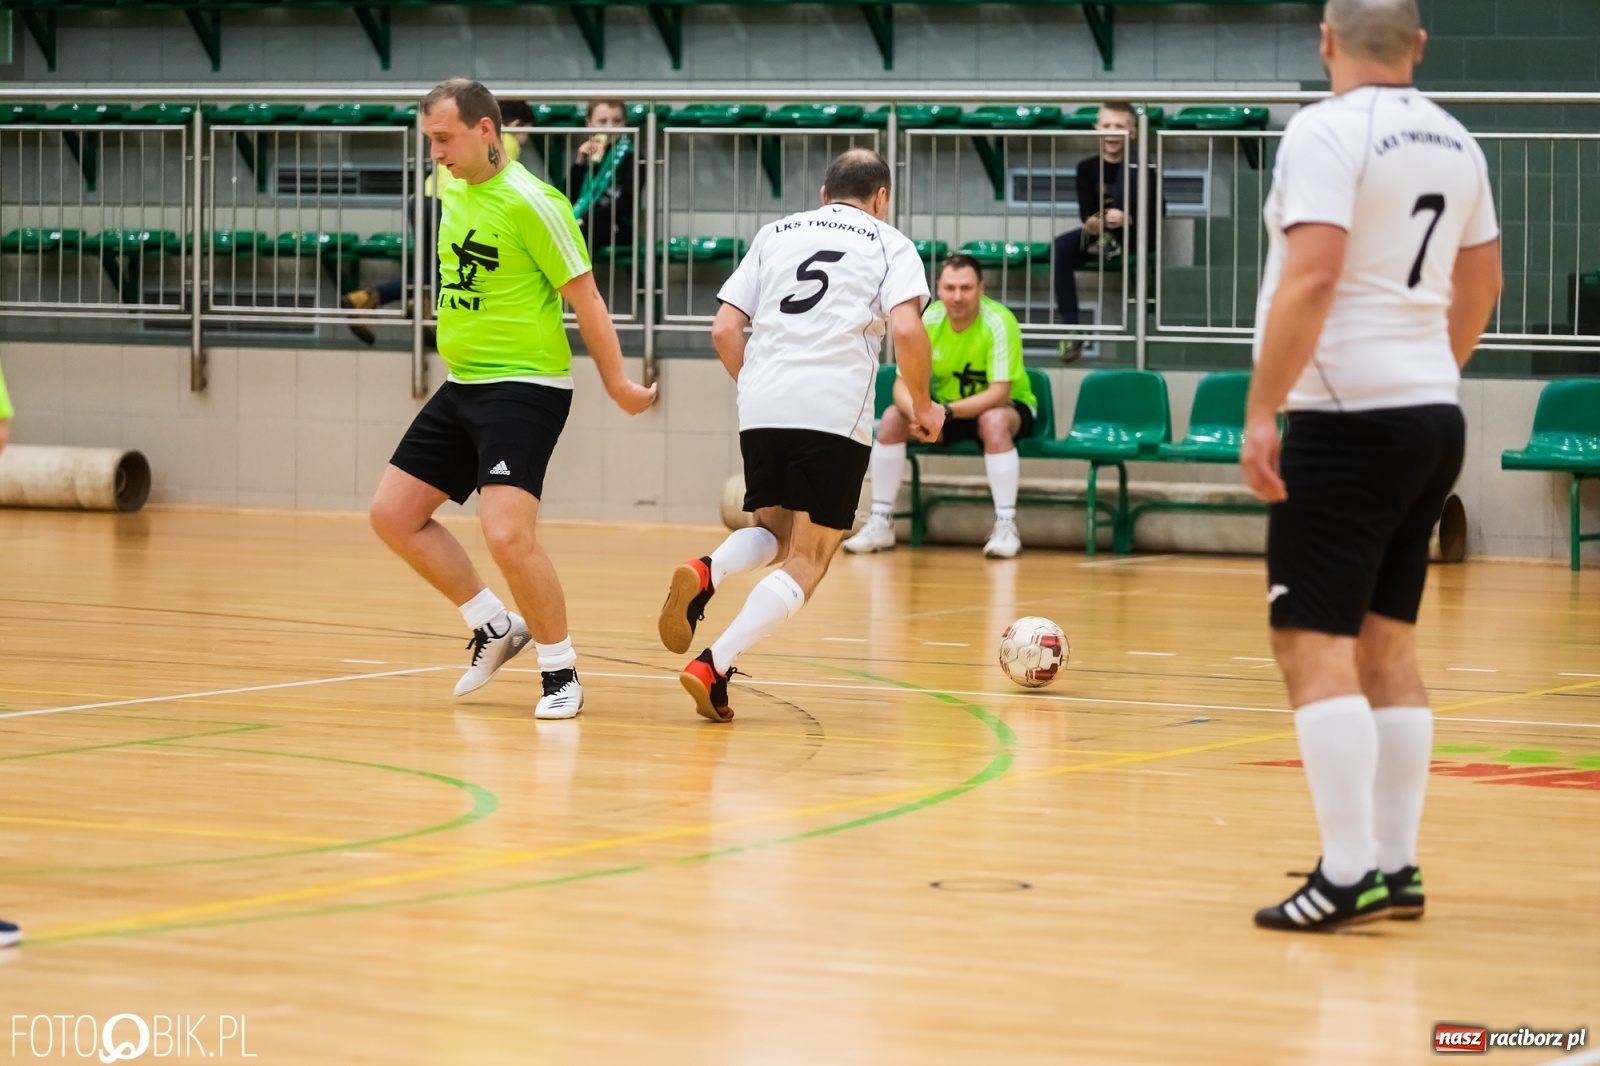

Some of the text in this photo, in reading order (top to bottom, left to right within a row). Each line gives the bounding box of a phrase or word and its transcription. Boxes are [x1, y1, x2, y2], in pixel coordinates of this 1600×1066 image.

[775, 220, 802, 234] LKS
[1408, 193, 1446, 289] 7
[779, 250, 847, 315] 5
